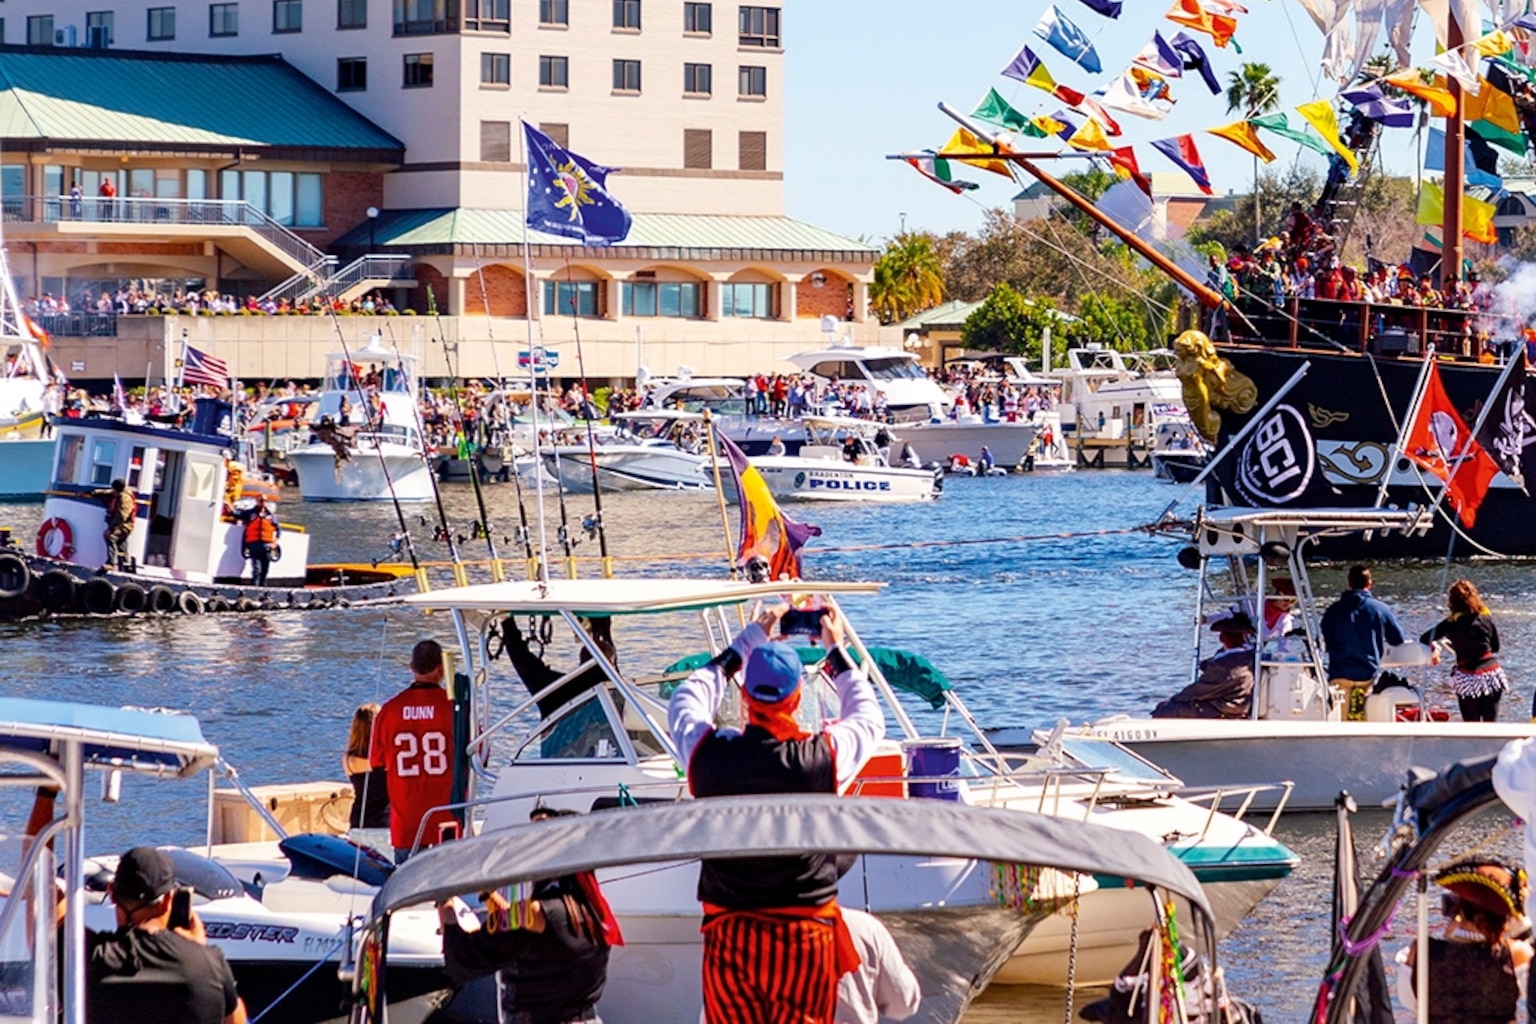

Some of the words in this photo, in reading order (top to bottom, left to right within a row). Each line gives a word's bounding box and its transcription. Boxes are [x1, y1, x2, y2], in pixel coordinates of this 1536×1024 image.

[809, 479, 891, 491] POLICE
[403, 705, 435, 720] DUNN
[394, 732, 448, 776] 28
